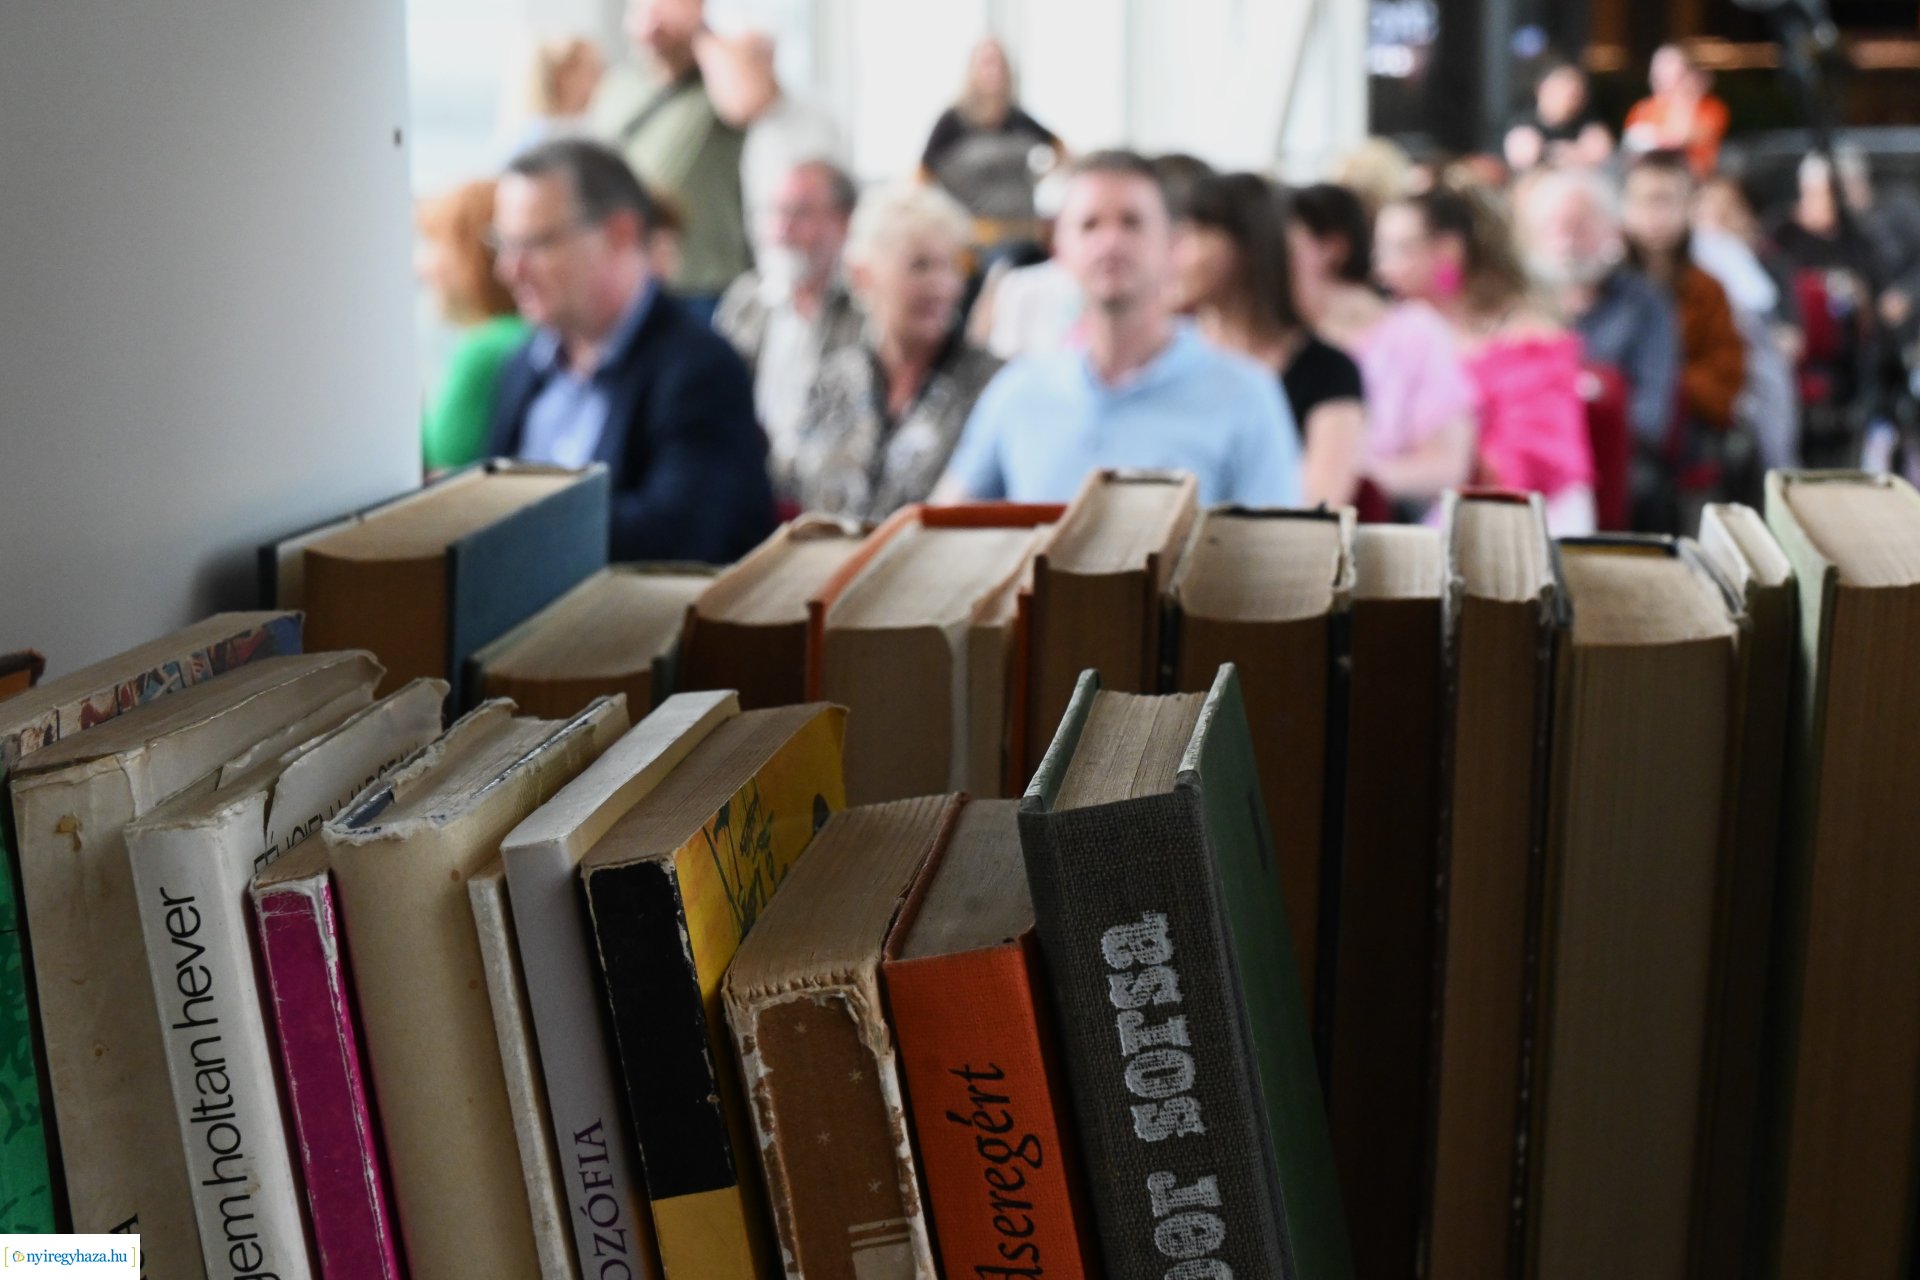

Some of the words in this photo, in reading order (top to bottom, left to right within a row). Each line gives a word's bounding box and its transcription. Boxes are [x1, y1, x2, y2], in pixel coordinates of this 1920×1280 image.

[159, 886, 219, 1029] hever
[1101, 910, 1207, 1142] sorsa
[190, 1036, 248, 1186] holtan
